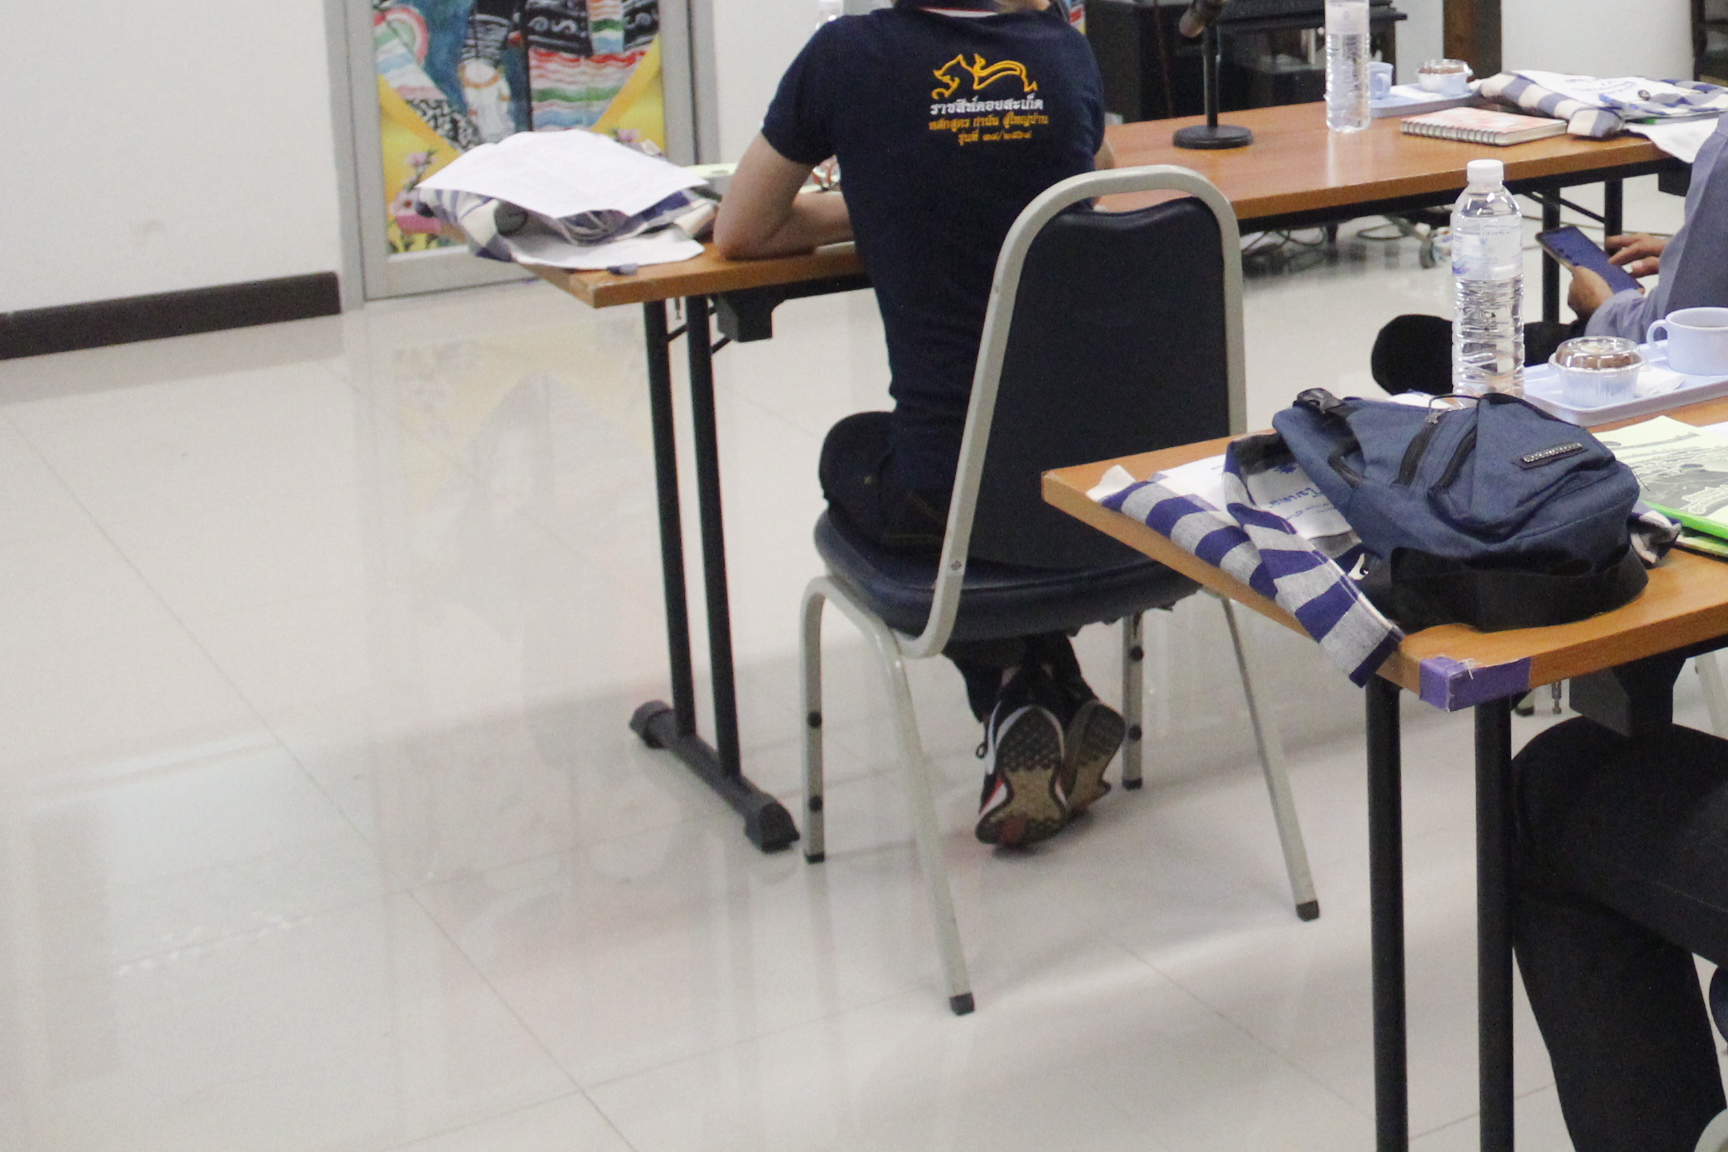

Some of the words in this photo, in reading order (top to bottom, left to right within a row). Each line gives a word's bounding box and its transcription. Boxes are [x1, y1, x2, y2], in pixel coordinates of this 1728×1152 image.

[929, 94, 1044, 115] ราชสีห์ดอยสะเก็ด
